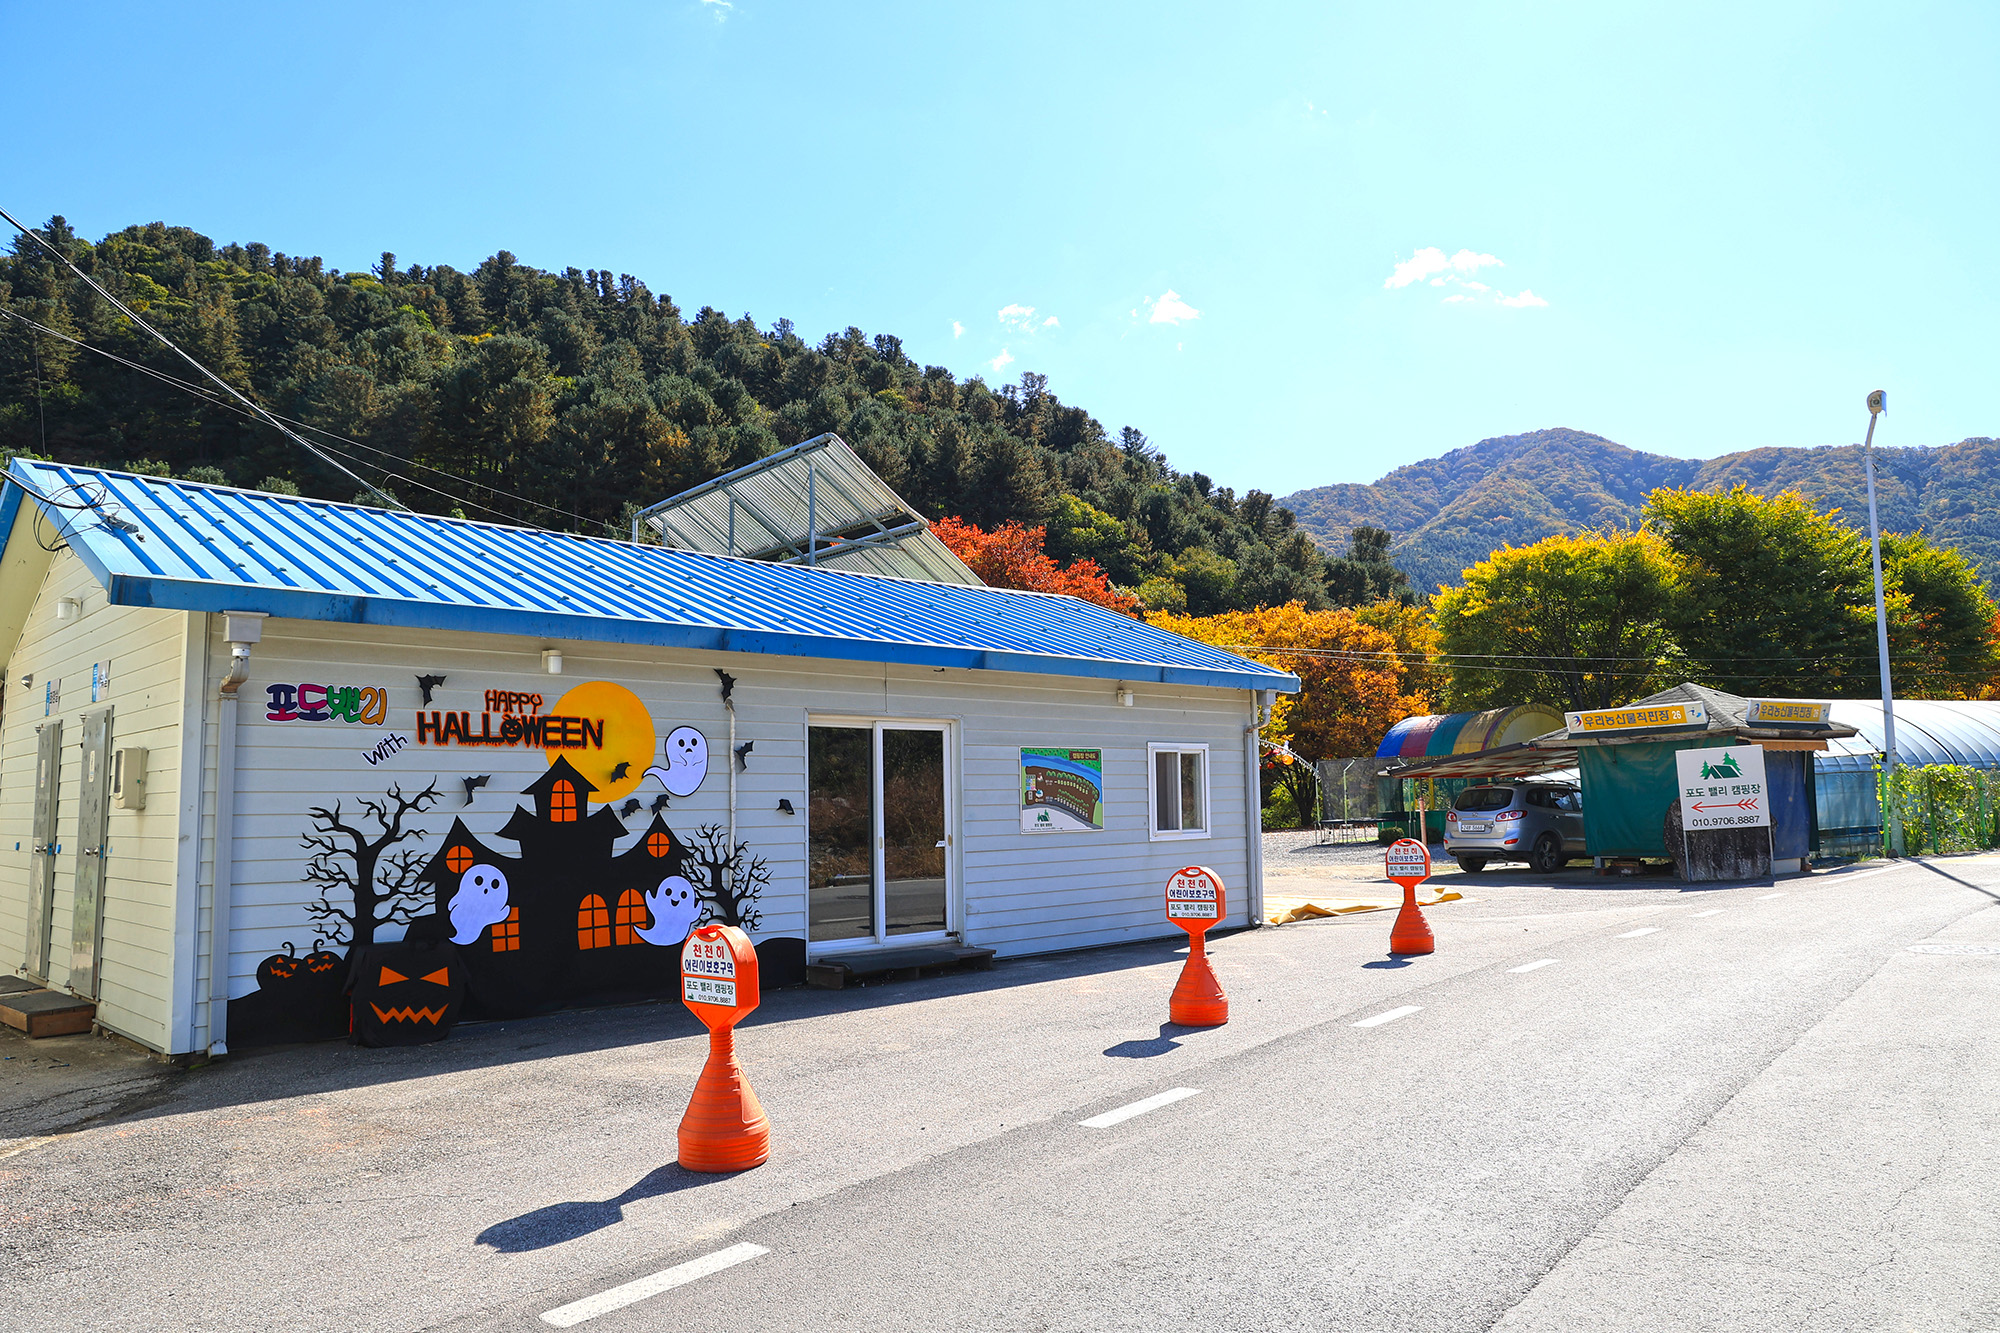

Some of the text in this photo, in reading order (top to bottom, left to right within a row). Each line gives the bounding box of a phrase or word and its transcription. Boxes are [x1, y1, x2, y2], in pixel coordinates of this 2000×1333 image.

[484, 689, 543, 715] HAPPY
[1584, 709, 1682, 727] 우리농산물직판장 26
[1761, 704, 1813, 718] 우리농산물직판장
[416, 711, 604, 750] HALLOWEEN
[362, 733, 408, 766] with
[1685, 783, 1761, 797] 포도 밸리 캠핑장
[1692, 815, 1760, 827] 010.9706.8887
[1169, 889, 1215, 899] 어린이보호구역
[684, 958, 734, 975] 어린이보호구역
[686, 980, 734, 995] 포도 밸리 캠핑장
[698, 994, 732, 1004] 010.9706.8887
